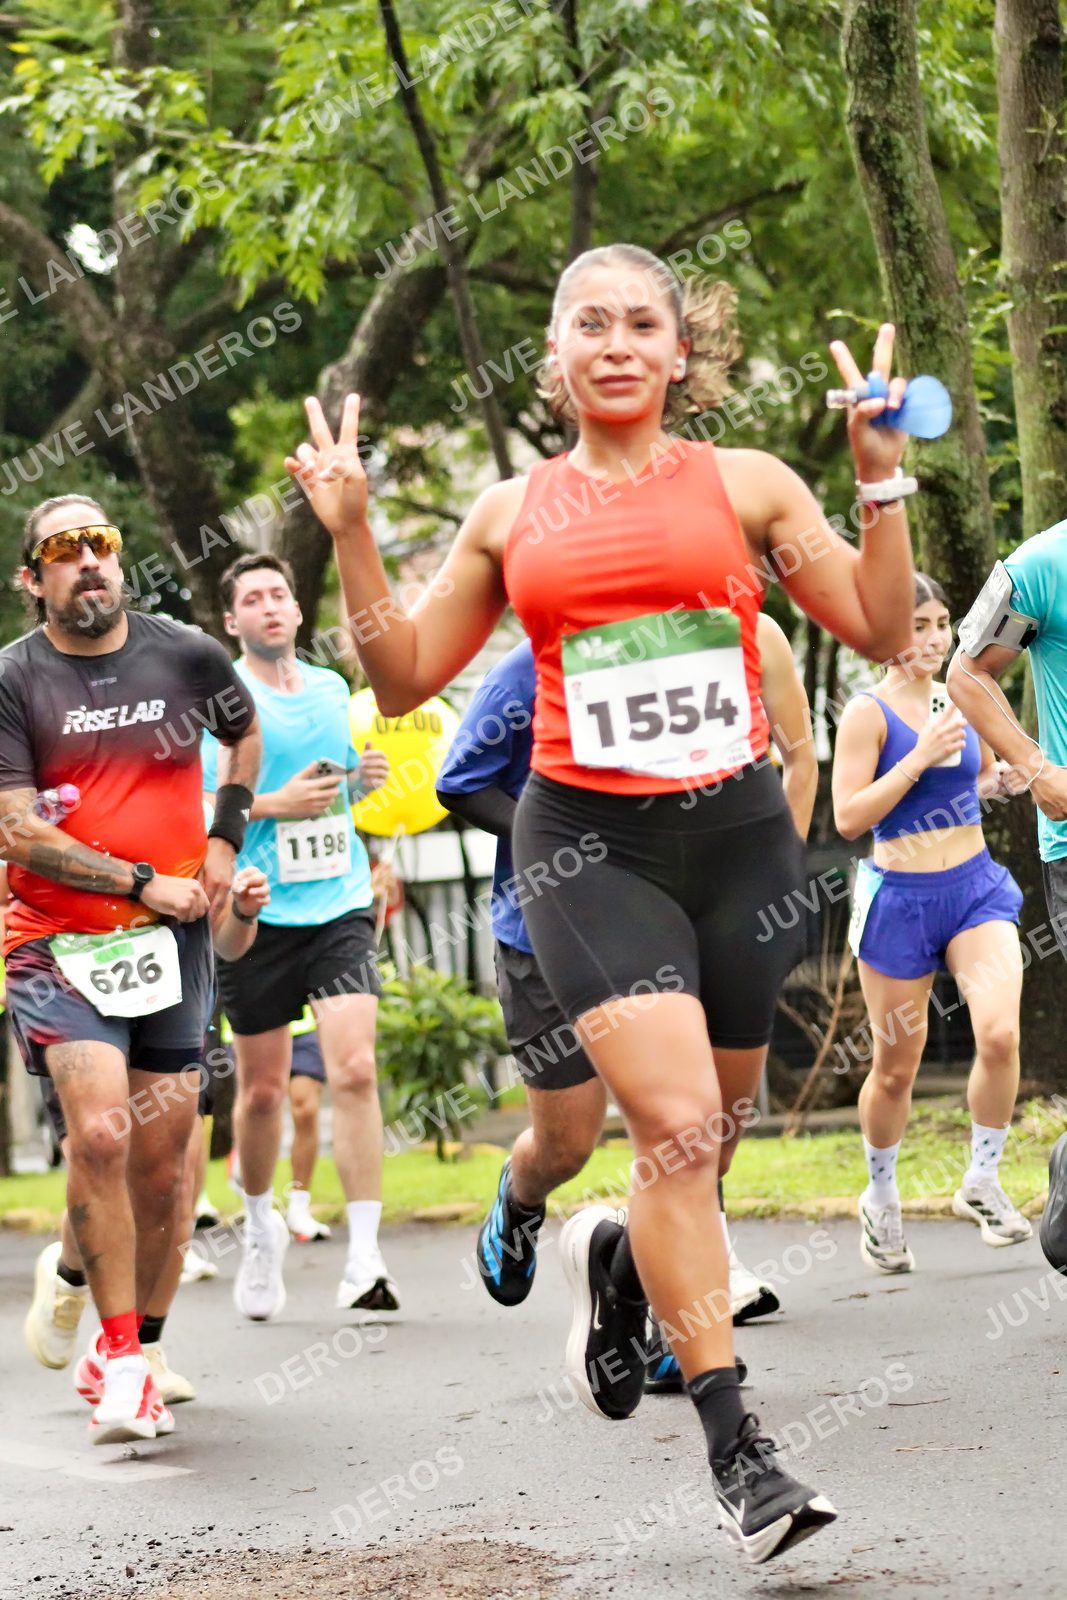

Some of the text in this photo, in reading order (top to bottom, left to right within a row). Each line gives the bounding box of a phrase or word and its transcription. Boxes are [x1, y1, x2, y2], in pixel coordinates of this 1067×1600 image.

[586, 681, 738, 748] 1554
[286, 831, 346, 860] 1198
[90, 952, 162, 994] 626
